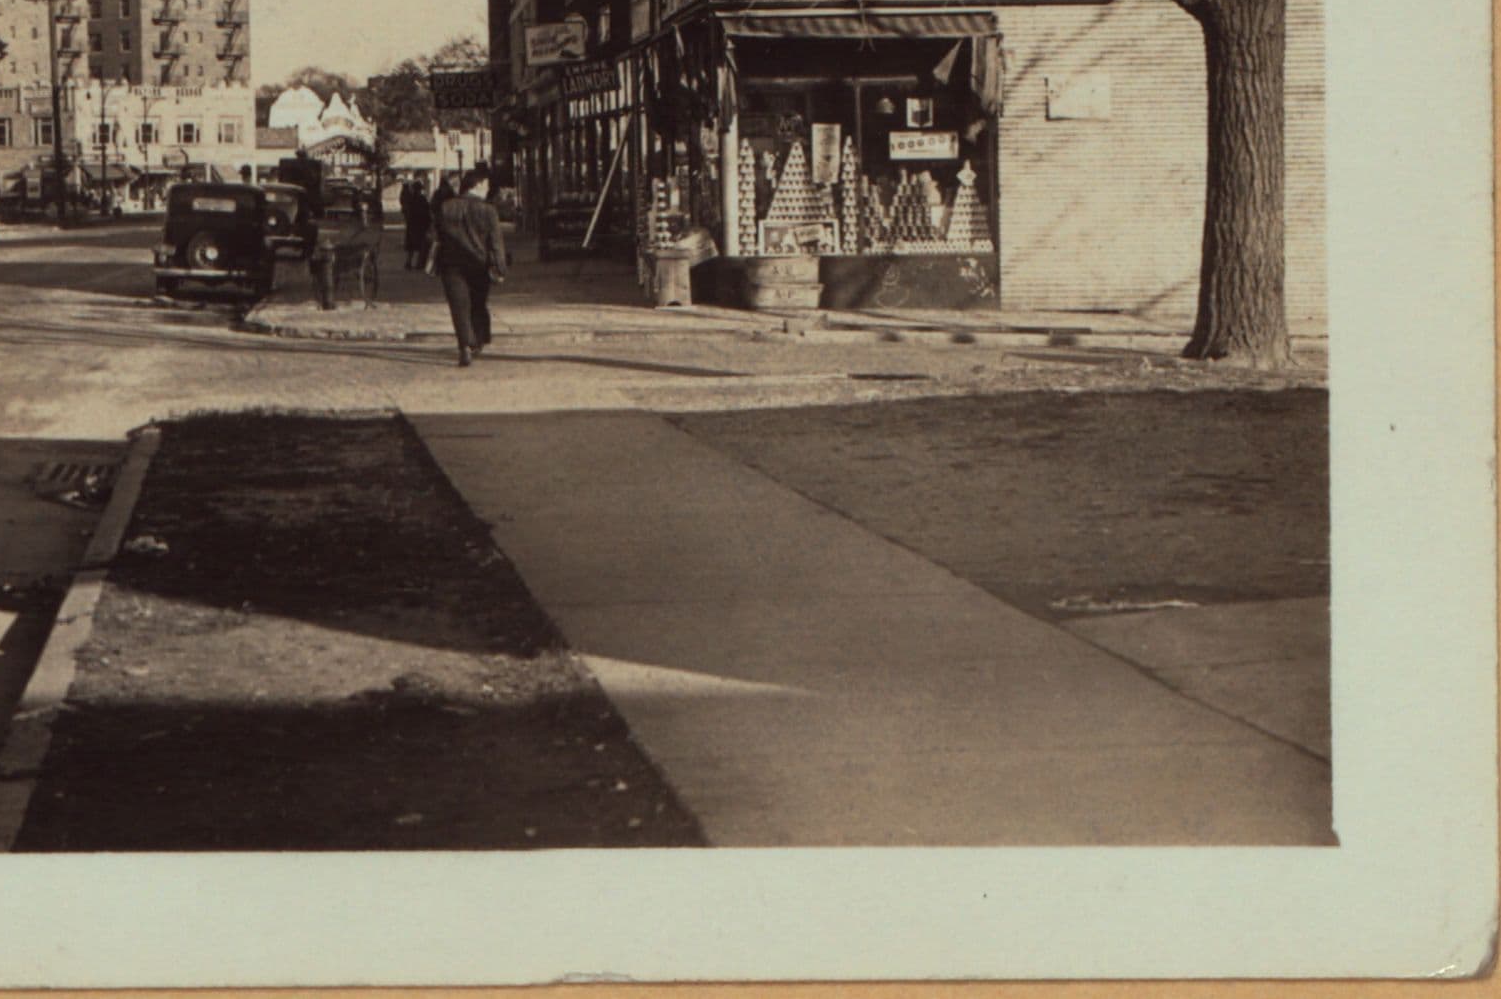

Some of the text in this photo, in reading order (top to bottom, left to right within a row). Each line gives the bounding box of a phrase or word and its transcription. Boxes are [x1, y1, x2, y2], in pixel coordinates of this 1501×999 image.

[434, 74, 494, 90] DRUGS
[562, 70, 616, 95] LAUNDRY
[438, 92, 490, 107] SODA
